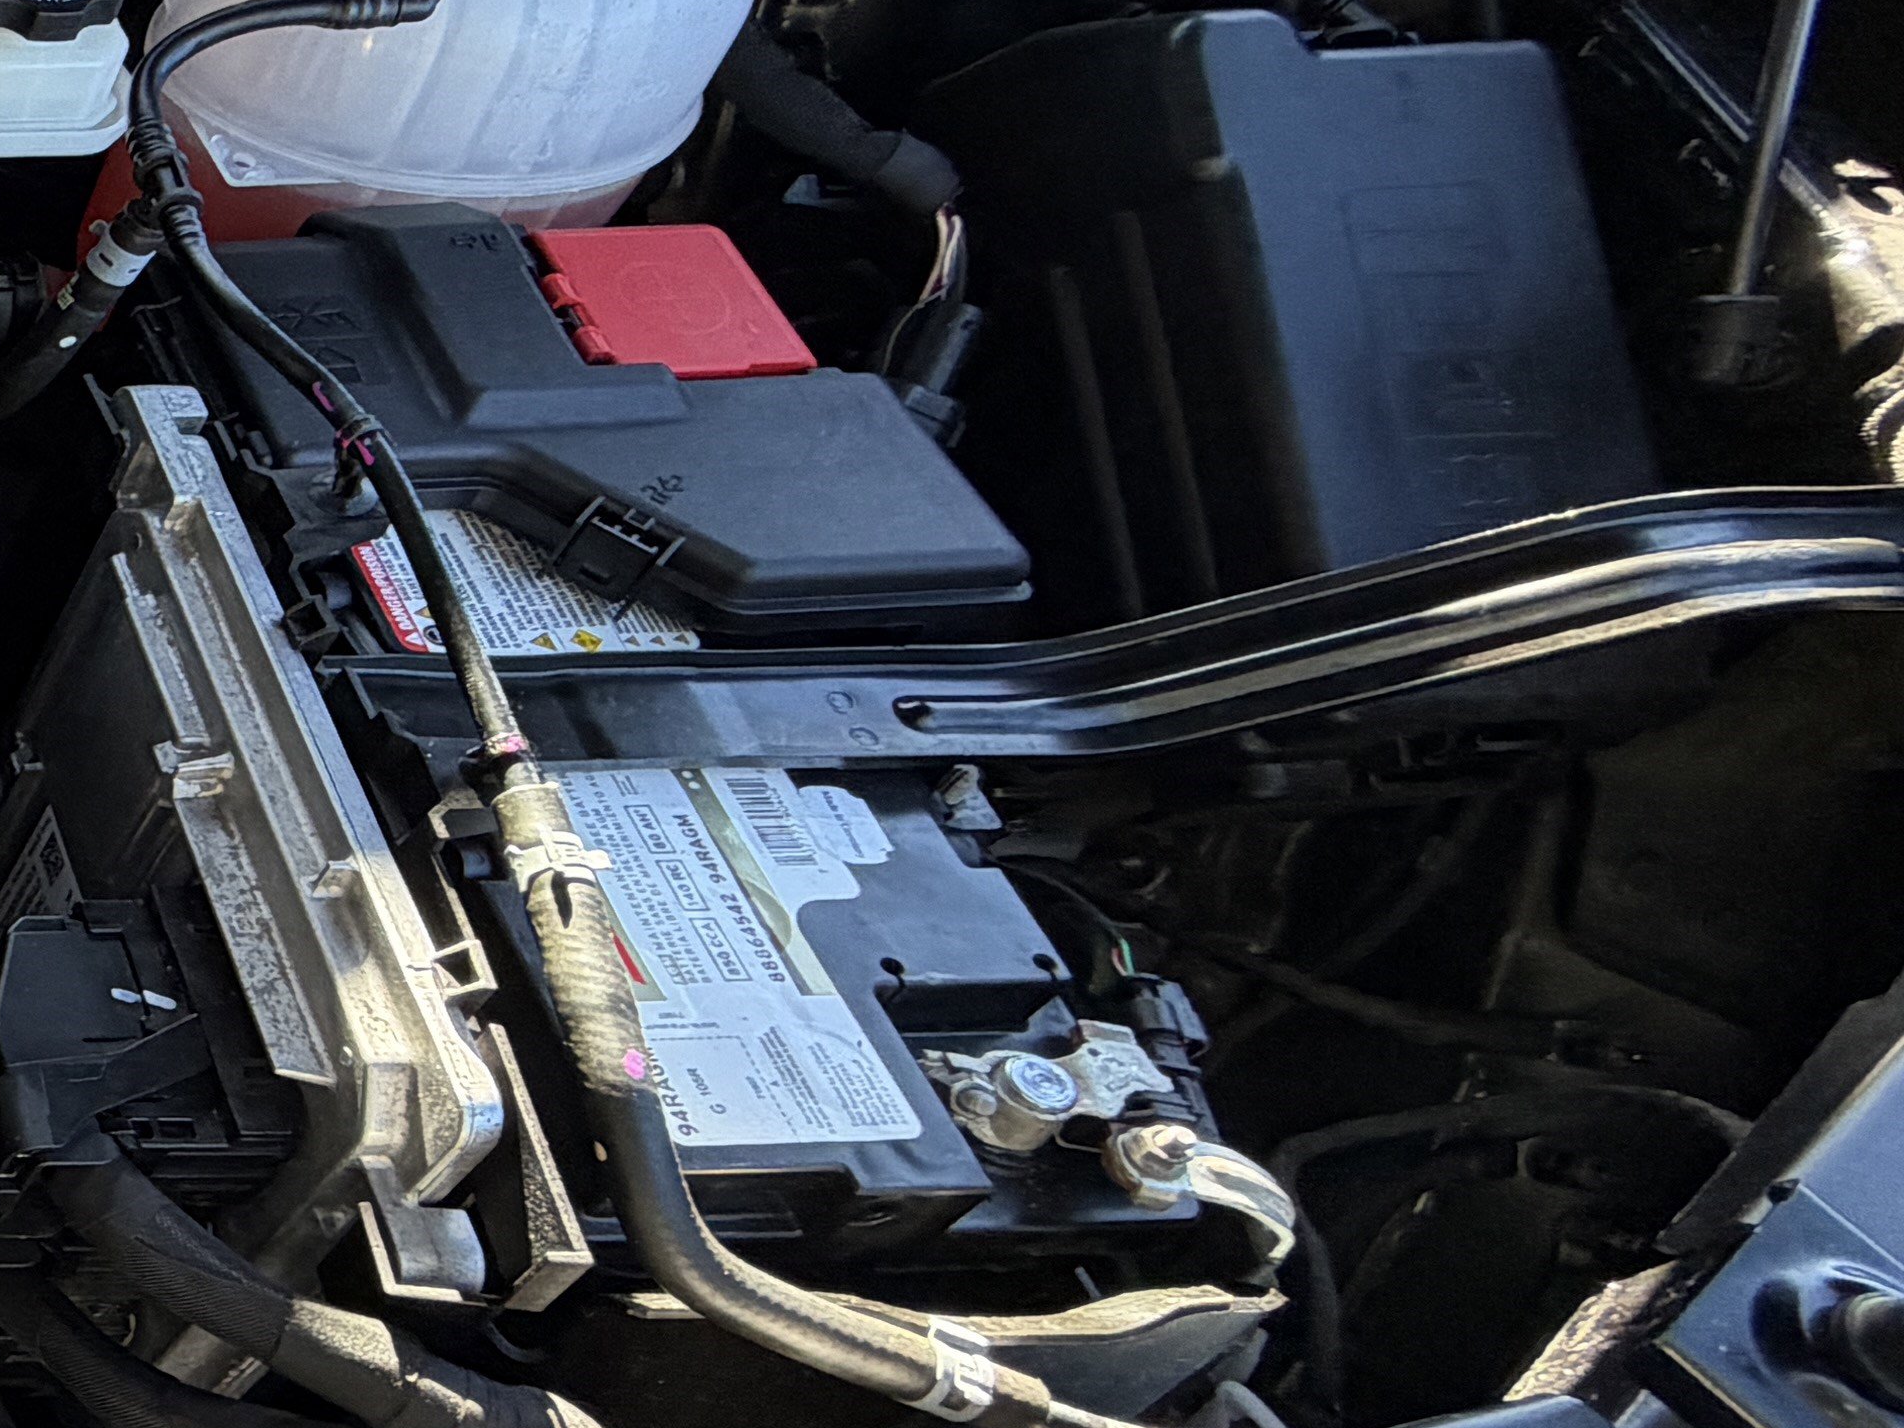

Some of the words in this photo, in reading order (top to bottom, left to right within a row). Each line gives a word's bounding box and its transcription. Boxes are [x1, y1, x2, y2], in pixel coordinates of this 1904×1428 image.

[676, 814, 727, 883] 94RAGM
[665, 864, 686, 881] RC
[677, 883, 699, 906] 140
[612, 865, 665, 951] MAINTENANC
[701, 922, 724, 948] CCA
[725, 894, 785, 983] 88864542
[716, 951, 741, 976] 850
